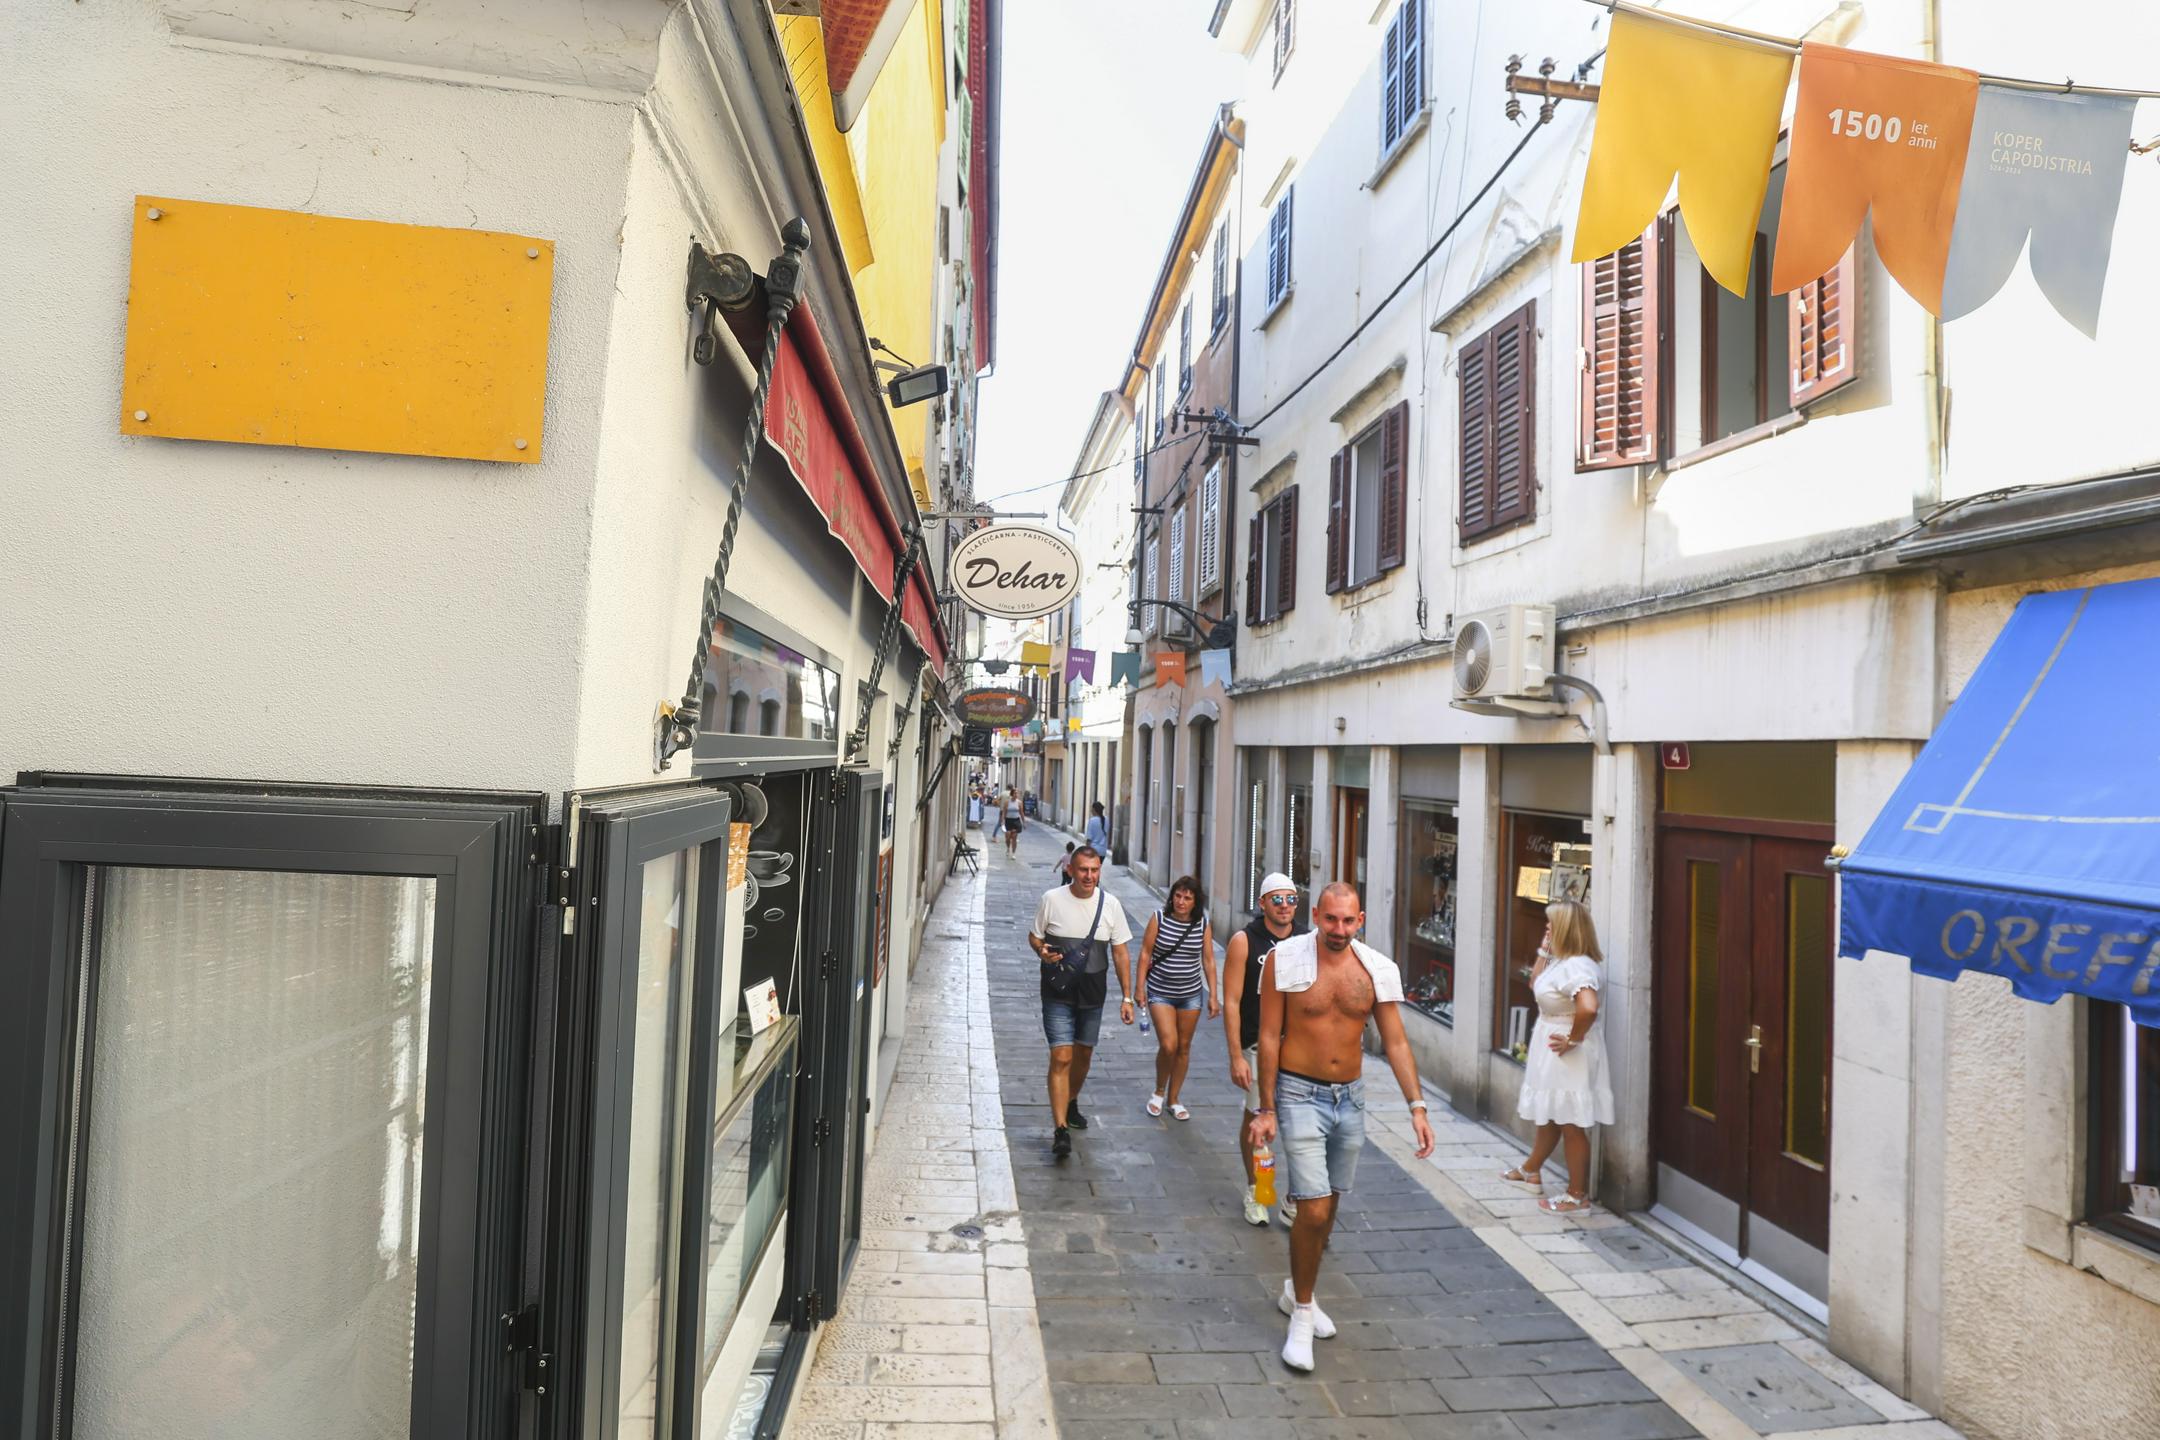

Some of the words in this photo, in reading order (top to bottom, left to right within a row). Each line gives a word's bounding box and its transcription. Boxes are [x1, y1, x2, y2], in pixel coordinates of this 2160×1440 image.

[1828, 107, 1902, 144] 1500
[1911, 120, 1929, 136] let
[1908, 136, 1937, 149] anni
[1993, 131, 2043, 152] KOPER
[1991, 148, 2093, 176] CAPODISTRIA
[1023, 532, 1067, 557] PASTICCERIA
[965, 557, 1068, 590] Dehar
[998, 602, 1015, 610] since
[1671, 747, 1681, 764] 4
